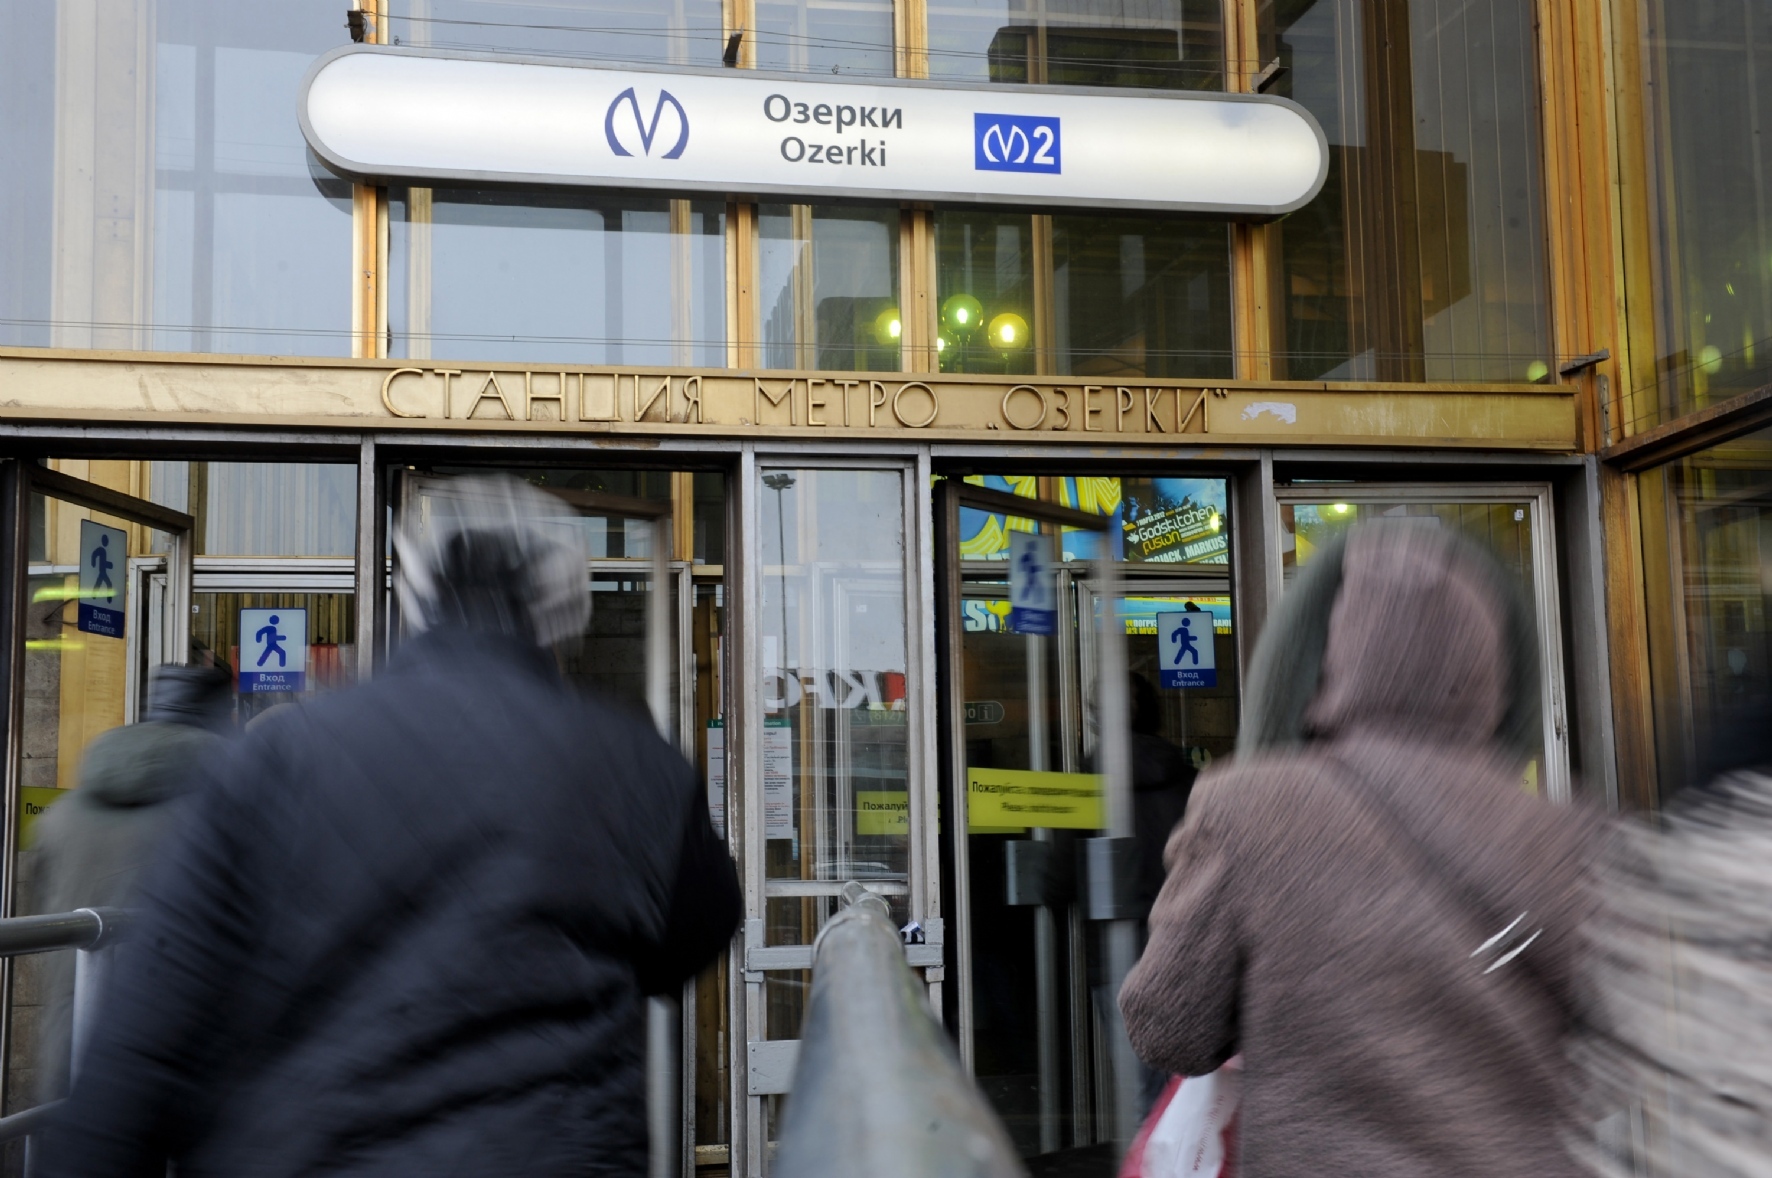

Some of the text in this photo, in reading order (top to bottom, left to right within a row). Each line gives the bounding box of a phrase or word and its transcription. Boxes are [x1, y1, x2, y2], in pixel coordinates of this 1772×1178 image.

[763, 93, 903, 134] Озерки
[780, 136, 887, 167] Ozerki
[381, 367, 704, 425] СТАНЦИЯ
[754, 377, 939, 429] МЕТРО
[1138, 505, 1215, 541] Godskitchen
[1184, 536, 1227, 558] MARKUS
[92, 608, 111, 624] Вход
[88, 620, 115, 635] Entrance
[1139, 627, 1157, 635] МУЗ
[259, 673, 286, 683] Вход
[1171, 679, 1205, 687] Entrance
[1177, 671, 1199, 680] Вход
[252, 683, 292, 691] Entrance
[863, 801, 908, 812] Пожалуй
